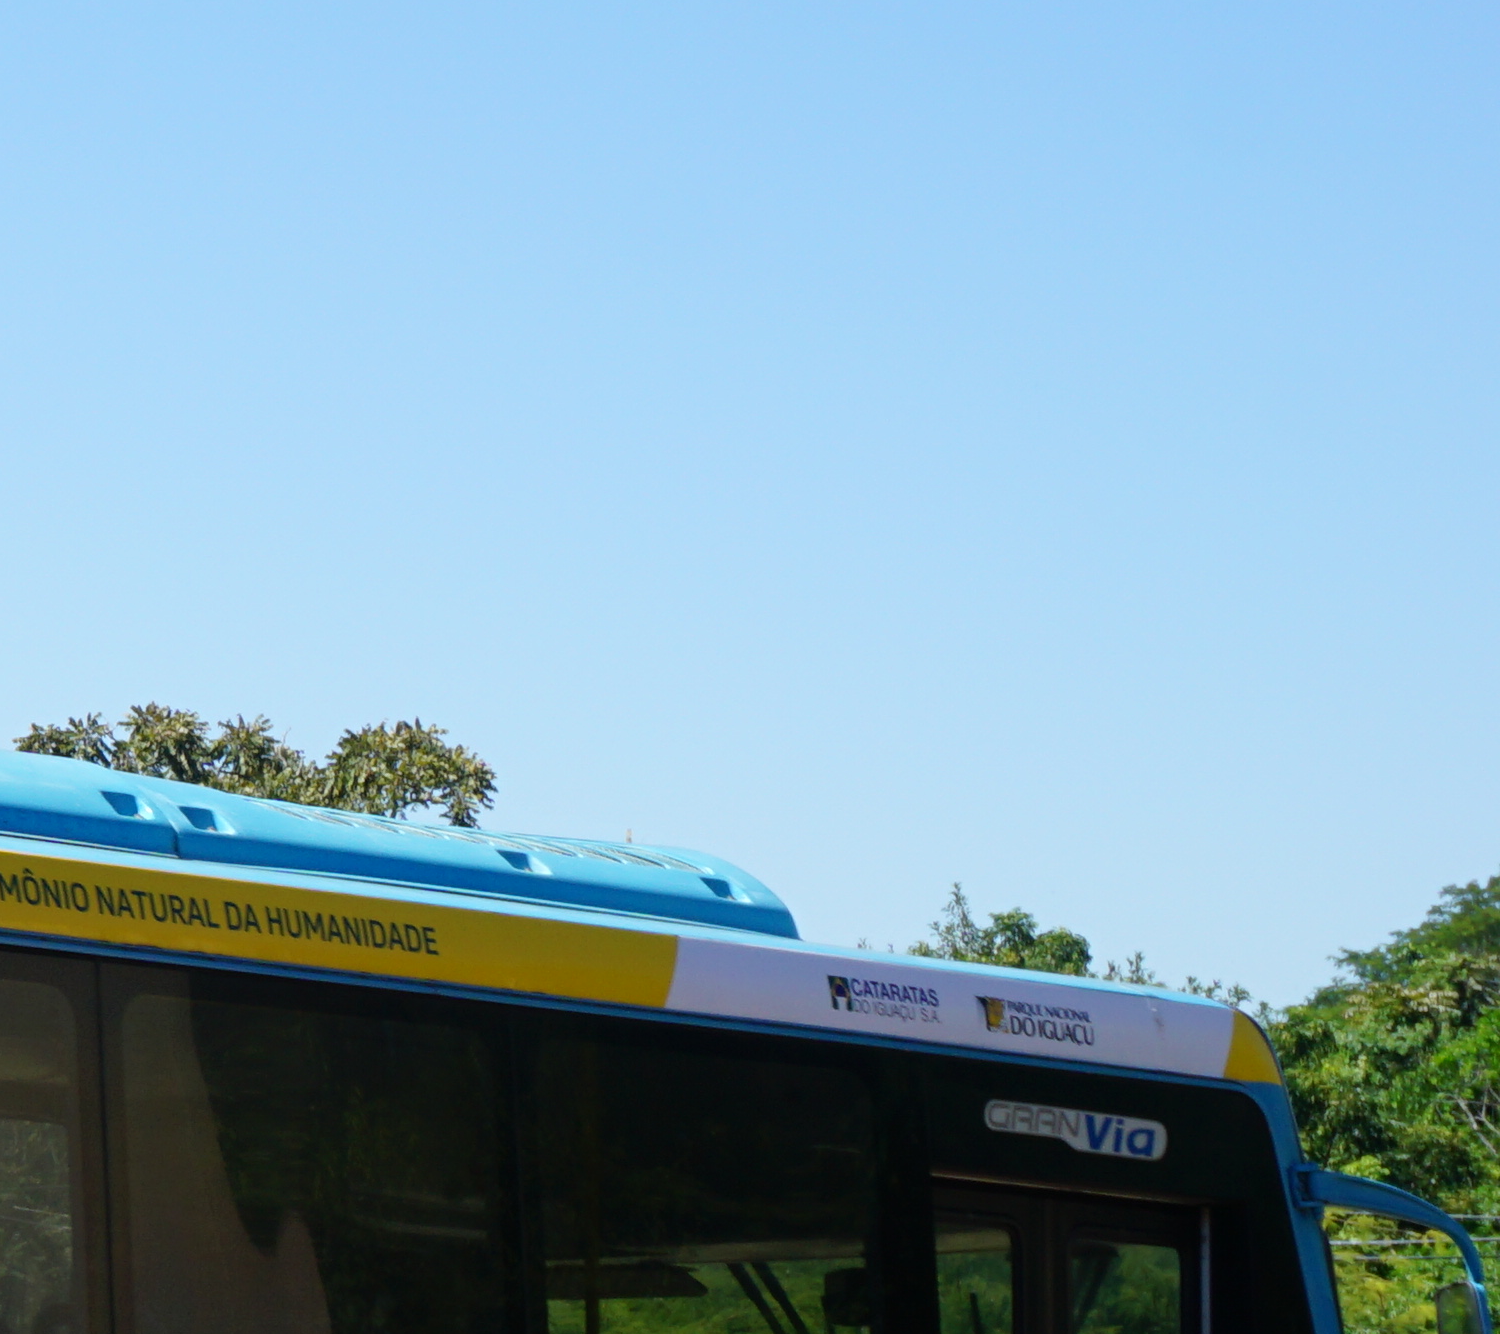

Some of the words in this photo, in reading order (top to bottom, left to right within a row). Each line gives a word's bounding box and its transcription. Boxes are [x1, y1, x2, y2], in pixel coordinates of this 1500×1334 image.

[95, 883, 221, 929] NATURAL
[224, 899, 262, 934] DA
[265, 905, 440, 956] HUMANIDADE
[850, 977, 940, 1008] CATARATAS
[851, 998, 871, 1014] DO
[1006, 999, 1043, 1017] PARQUE
[1044, 1005, 1092, 1023] NACIONAL
[1010, 1015, 1036, 1037] DO
